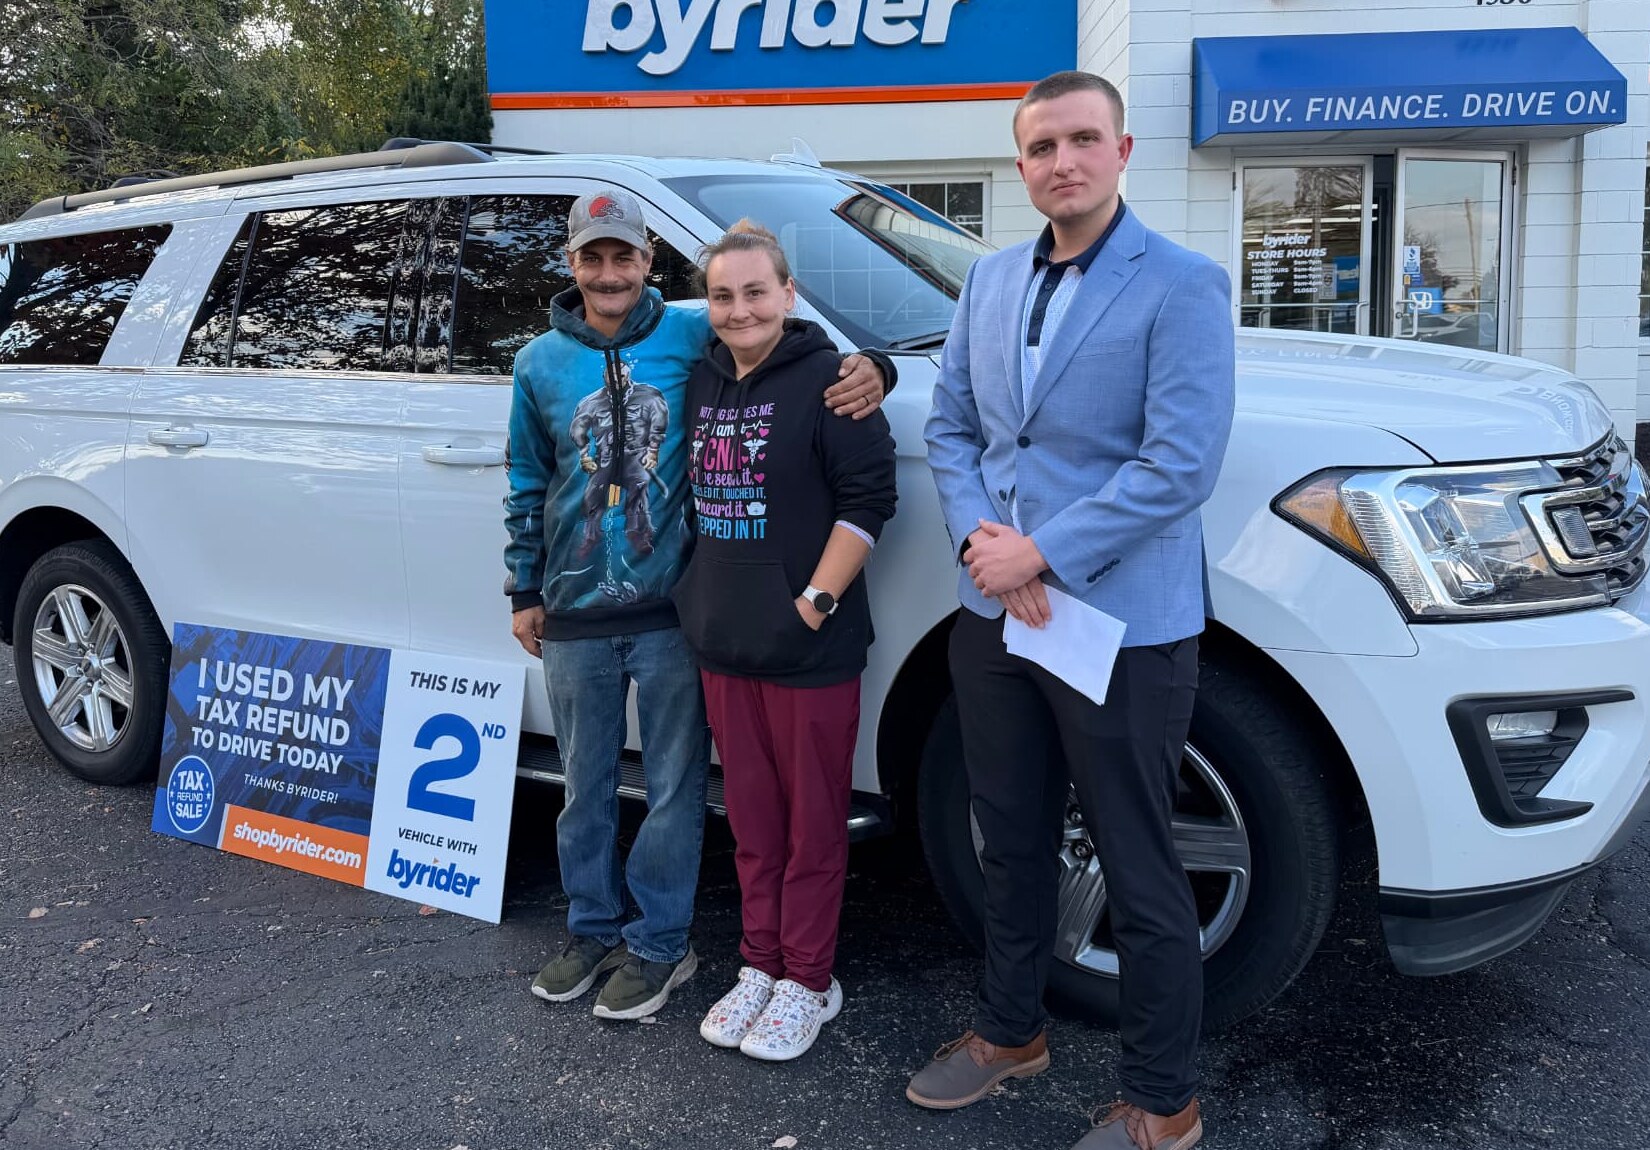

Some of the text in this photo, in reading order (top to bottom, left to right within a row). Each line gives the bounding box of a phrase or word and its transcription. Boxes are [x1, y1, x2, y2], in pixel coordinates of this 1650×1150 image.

[582, 0, 964, 76] byrider
[1227, 90, 1618, 124] BUY. FINANCE. DRIVE ON.
[1262, 232, 1311, 248] byrider
[1247, 248, 1327, 260] STORE HOURS
[759, 402, 775, 416] ME
[717, 424, 736, 437] am
[722, 487, 755, 499] TOUCHED
[700, 498, 747, 518] heard it.
[735, 519, 749, 540] IN
[753, 518, 768, 540] IT
[198, 657, 354, 711] I USED MY
[410, 671, 502, 700] THIS IS MY
[196, 695, 350, 746] TAX REFUND
[191, 726, 344, 775] TO DRIVE TODAY
[178, 770, 204, 791] TAX
[244, 773, 339, 804] THANKS BYRIDER!
[177, 791, 203, 802] REFUND
[175, 803, 203, 819] SALE
[233, 821, 361, 869] shopbyrider.com
[398, 827, 478, 856] VEHICLE WITH
[387, 849, 480, 898] byrider
